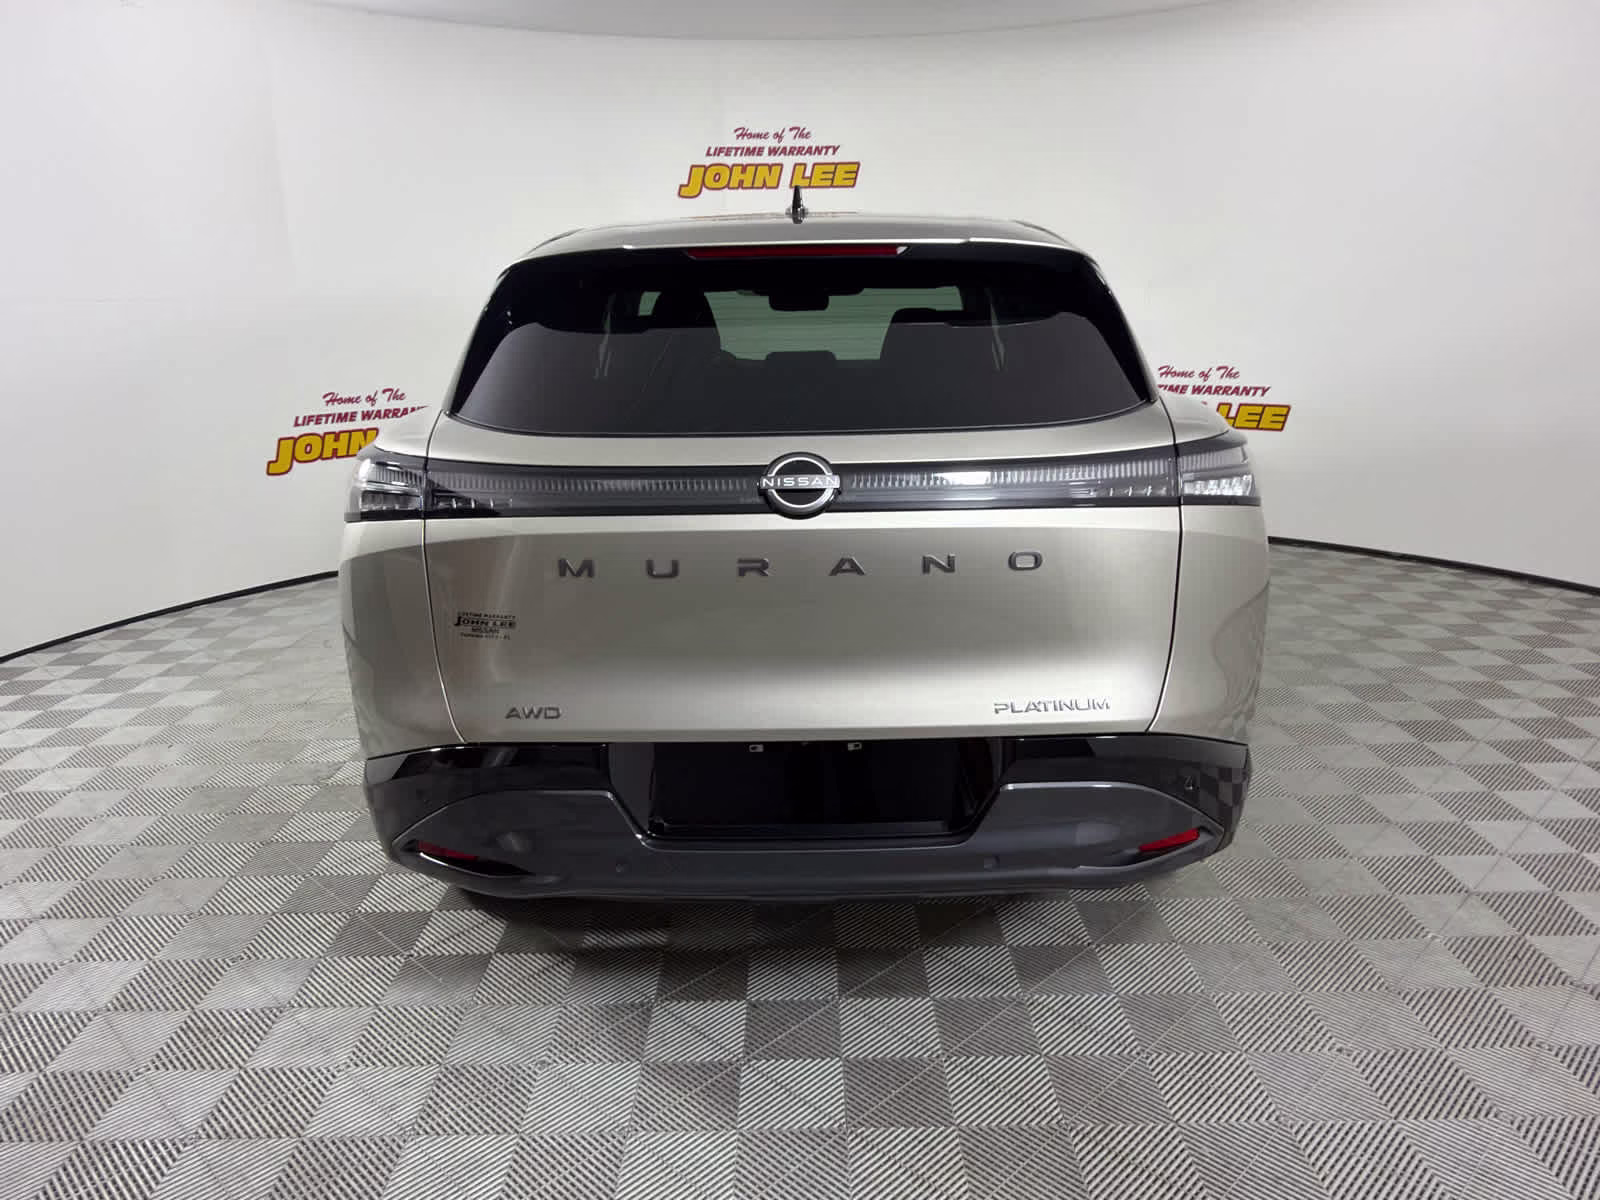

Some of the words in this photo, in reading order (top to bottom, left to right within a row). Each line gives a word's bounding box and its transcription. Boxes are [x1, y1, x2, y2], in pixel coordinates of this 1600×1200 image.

[733, 127, 770, 140] Home
[773, 127, 784, 143] of
[789, 126, 812, 140] The
[705, 146, 764, 158] LIFETIME
[767, 145, 840, 157] WARRANTY
[678, 163, 783, 199] JOHN
[789, 162, 860, 189] LEE
[1158, 365, 1195, 379] Home
[1198, 368, 1212, 382] of
[1216, 366, 1240, 379] The
[322, 392, 362, 406] Home
[365, 391, 378, 406] of
[382, 388, 406, 401] The
[1191, 385, 1271, 397] WARRANTY
[293, 411, 358, 427] LIFETIME
[1216, 402, 1291, 432] LEE
[266, 428, 379, 475] JOHN
[762, 477, 838, 487] NISSAN
[454, 616, 489, 626] JOHN
[505, 707, 561, 719] AWD
[994, 699, 1110, 714] PLATINUM
